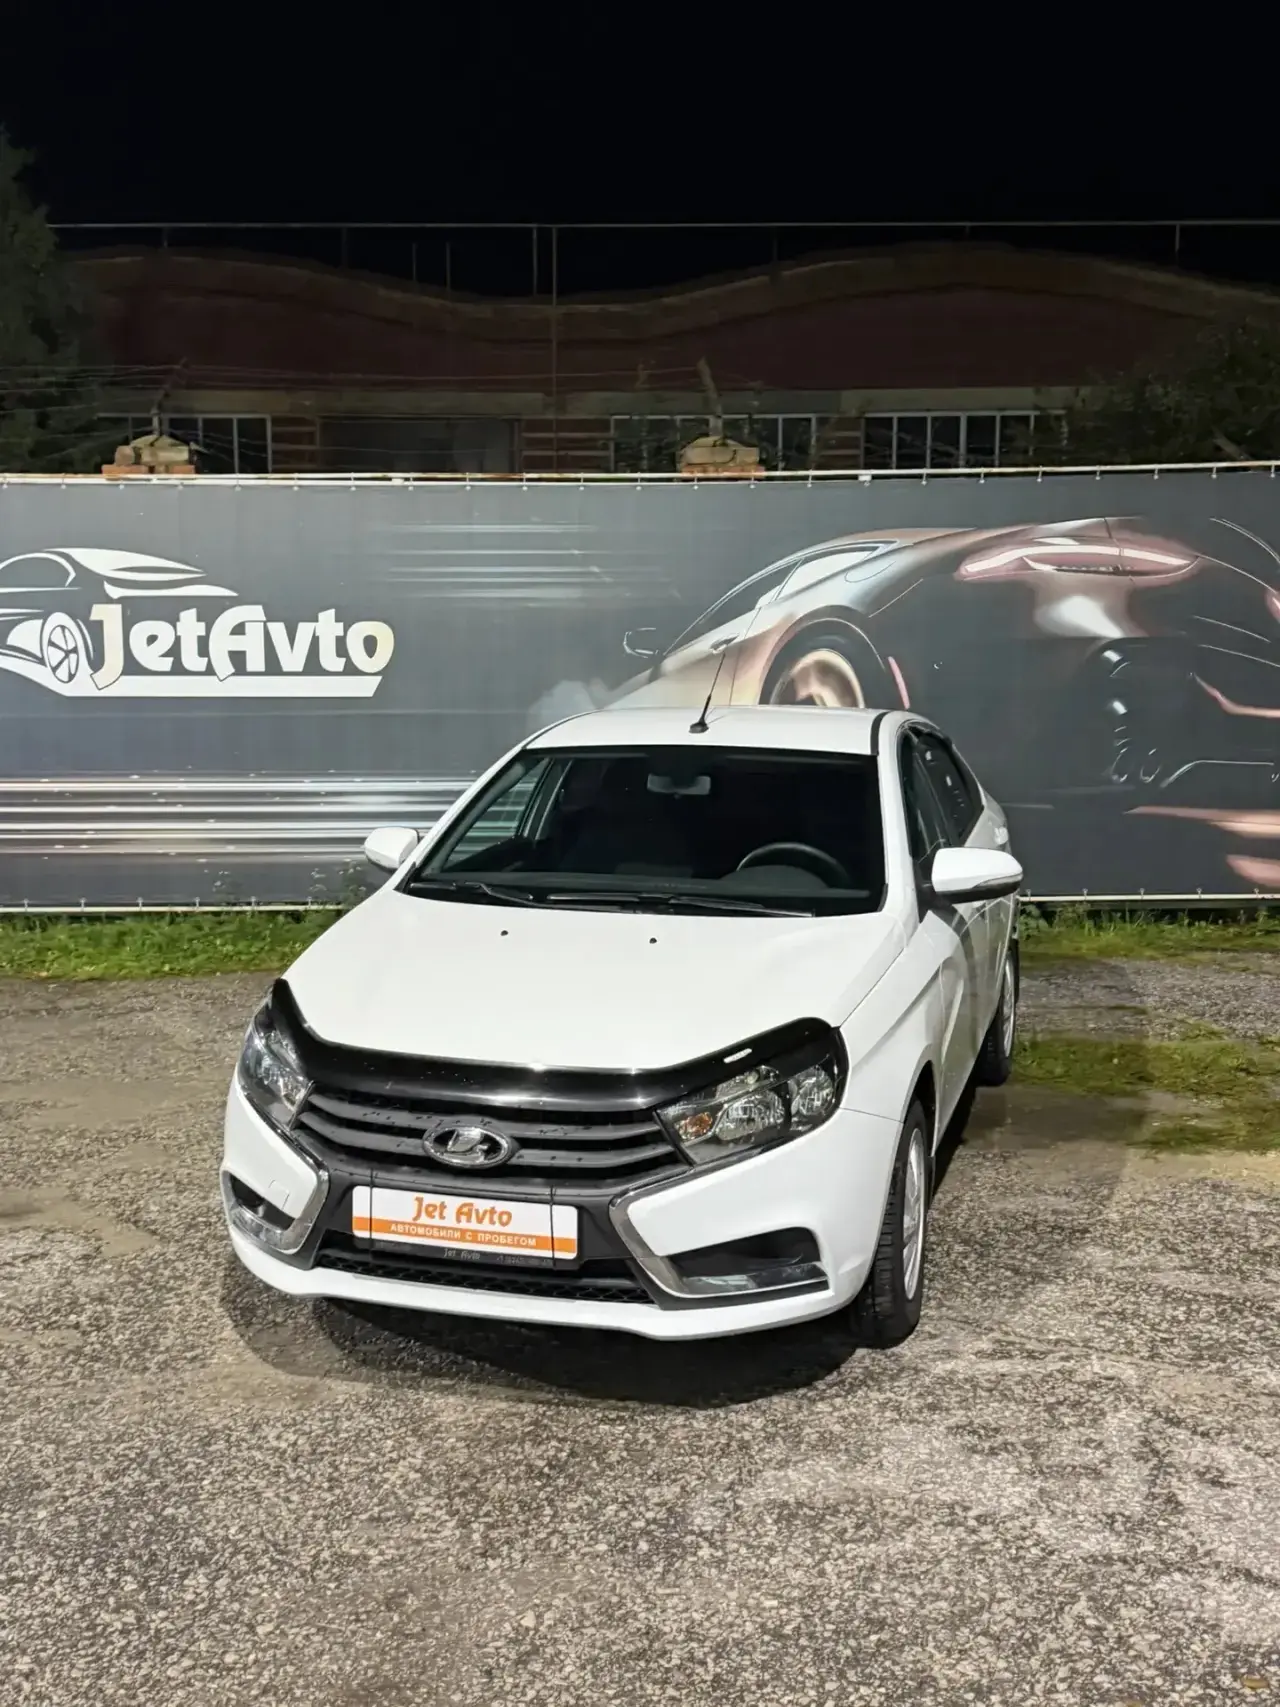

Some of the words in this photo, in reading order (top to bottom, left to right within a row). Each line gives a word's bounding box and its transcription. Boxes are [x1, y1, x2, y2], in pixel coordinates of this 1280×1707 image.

[89, 603, 395, 691] JetAvto
[411, 1196, 447, 1221] Jet
[455, 1202, 513, 1227] Avto
[390, 1223, 462, 1241] АВТОМОБИЛИ
[465, 1230, 473, 1241] С
[477, 1233, 537, 1247] ПРОБЕГОМ
